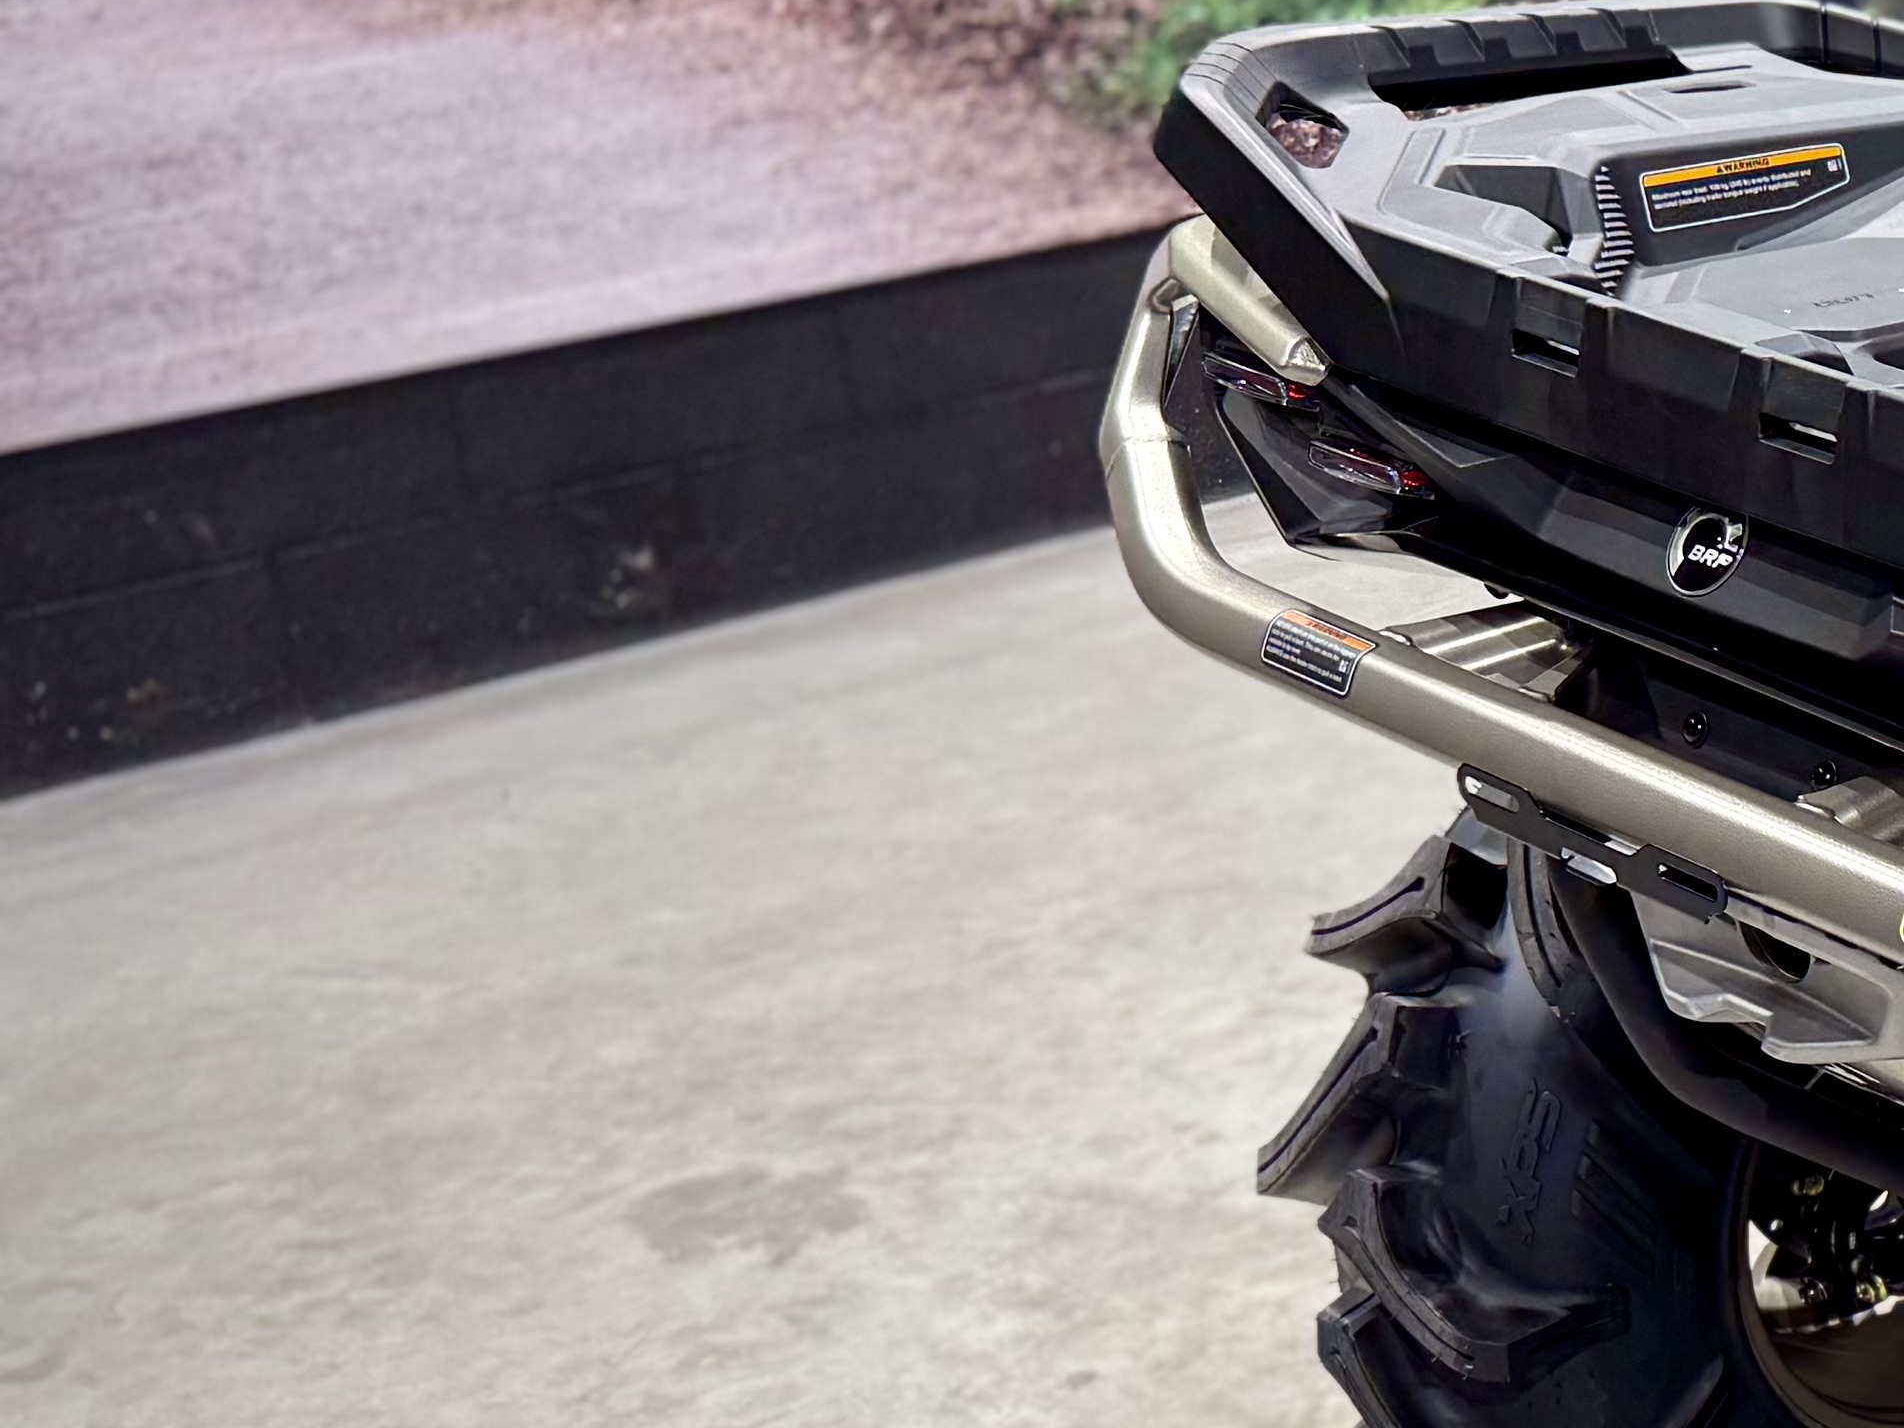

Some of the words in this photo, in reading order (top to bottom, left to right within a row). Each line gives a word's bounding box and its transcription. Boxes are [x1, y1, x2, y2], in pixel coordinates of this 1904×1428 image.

[1725, 157, 1770, 172] WARNING
[1687, 544, 1734, 569] BRP
[1496, 1077, 1564, 1247] XPS
